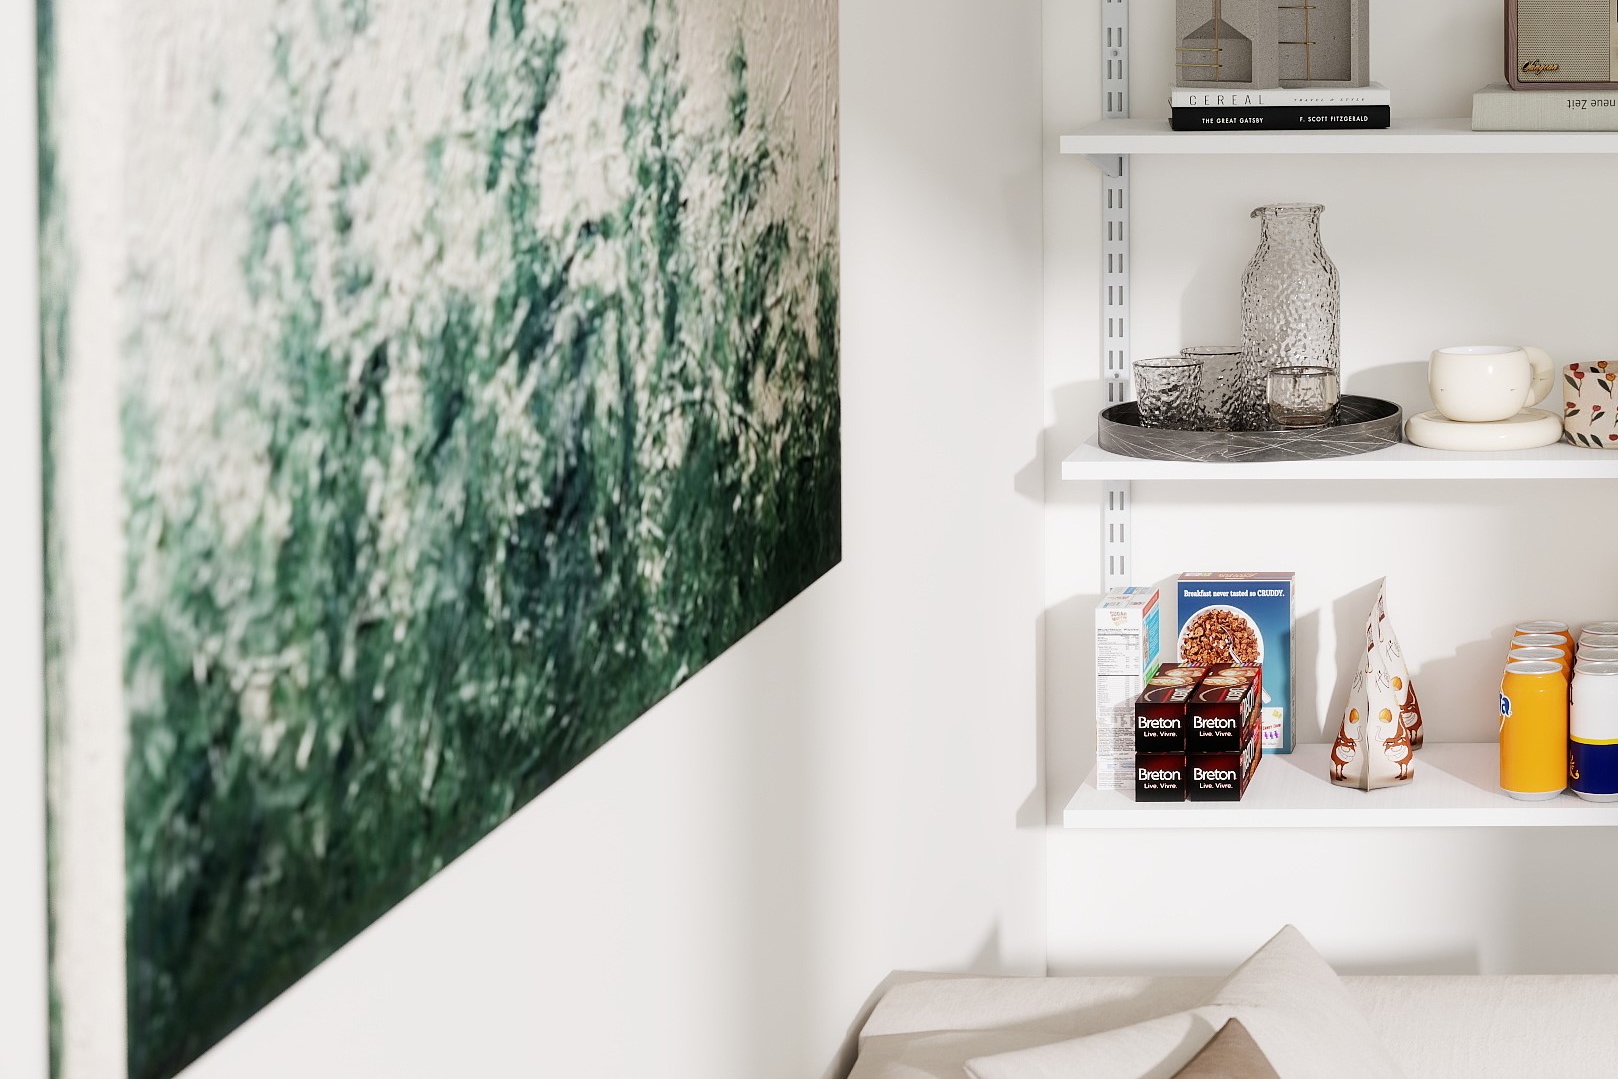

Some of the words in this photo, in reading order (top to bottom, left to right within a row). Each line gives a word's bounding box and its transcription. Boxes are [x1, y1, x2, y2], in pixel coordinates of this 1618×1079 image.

[1190, 95, 1264, 105] CEREAL
[1567, 99, 1586, 109] Zeit
[1590, 99, 1615, 107] neue
[1138, 716, 1181, 728] Breton
[1193, 716, 1236, 729] Breton
[1138, 768, 1181, 780] Breton
[1193, 768, 1237, 780] Breton
